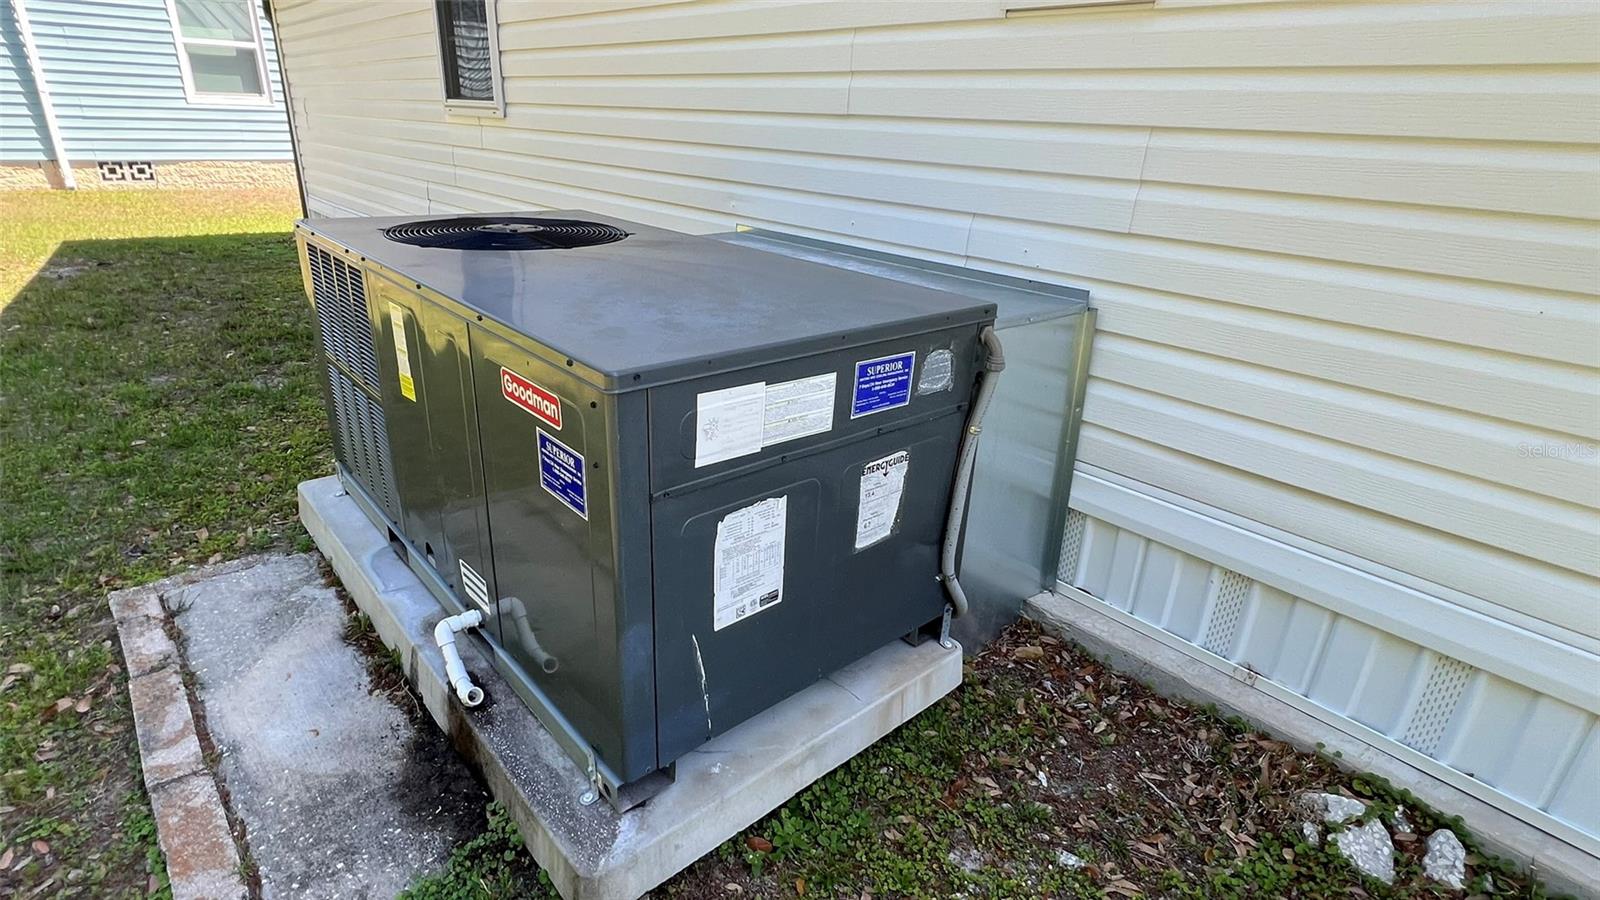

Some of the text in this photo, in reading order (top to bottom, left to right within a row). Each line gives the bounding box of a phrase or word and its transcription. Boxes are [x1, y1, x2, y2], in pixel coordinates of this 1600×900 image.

[867, 361, 903, 376] SUPERIOR
[503, 373, 559, 421] Goodman
[545, 440, 576, 469] SUPERIOR
